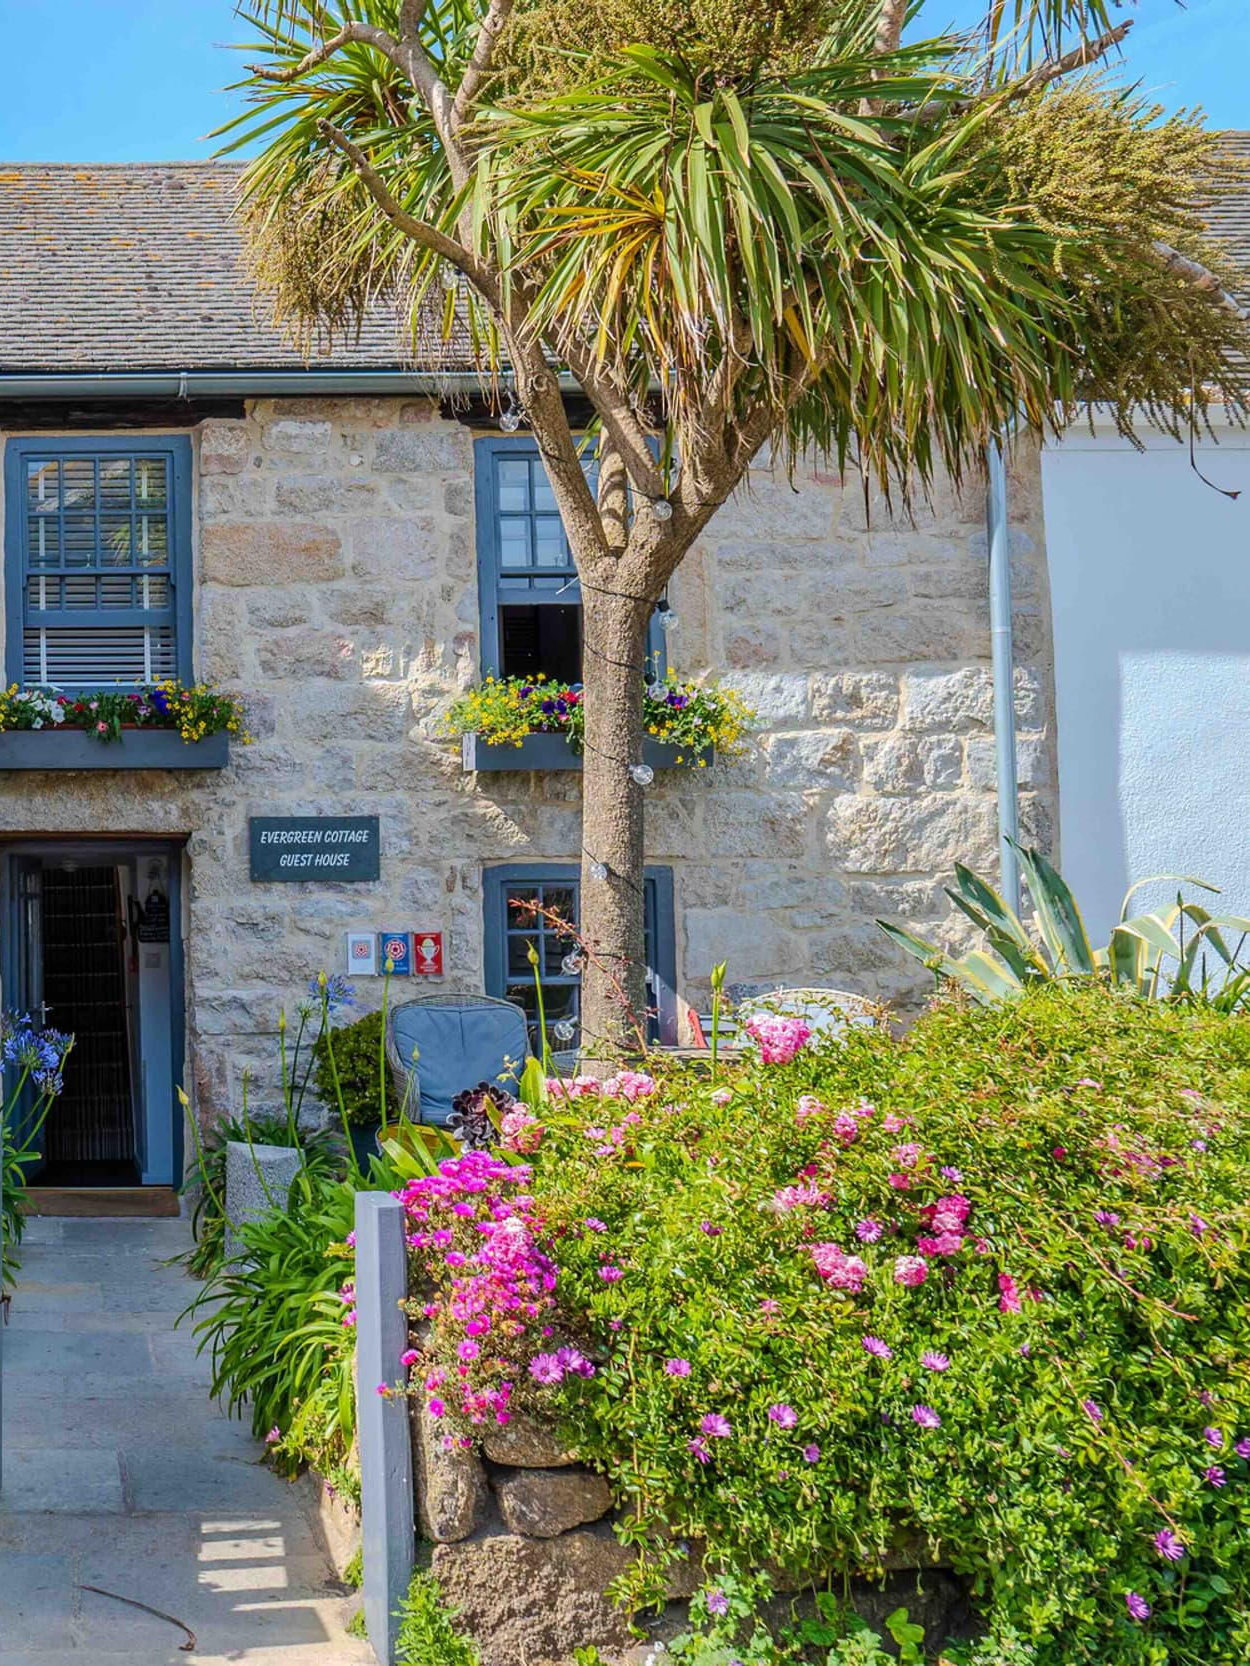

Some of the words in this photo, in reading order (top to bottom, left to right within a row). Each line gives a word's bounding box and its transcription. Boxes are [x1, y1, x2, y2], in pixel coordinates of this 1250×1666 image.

[260, 831, 322, 844] EVERGREEN
[324, 830, 370, 843] COTTAGE
[279, 853, 313, 867] GUEST
[314, 853, 351, 867] HOUSE
